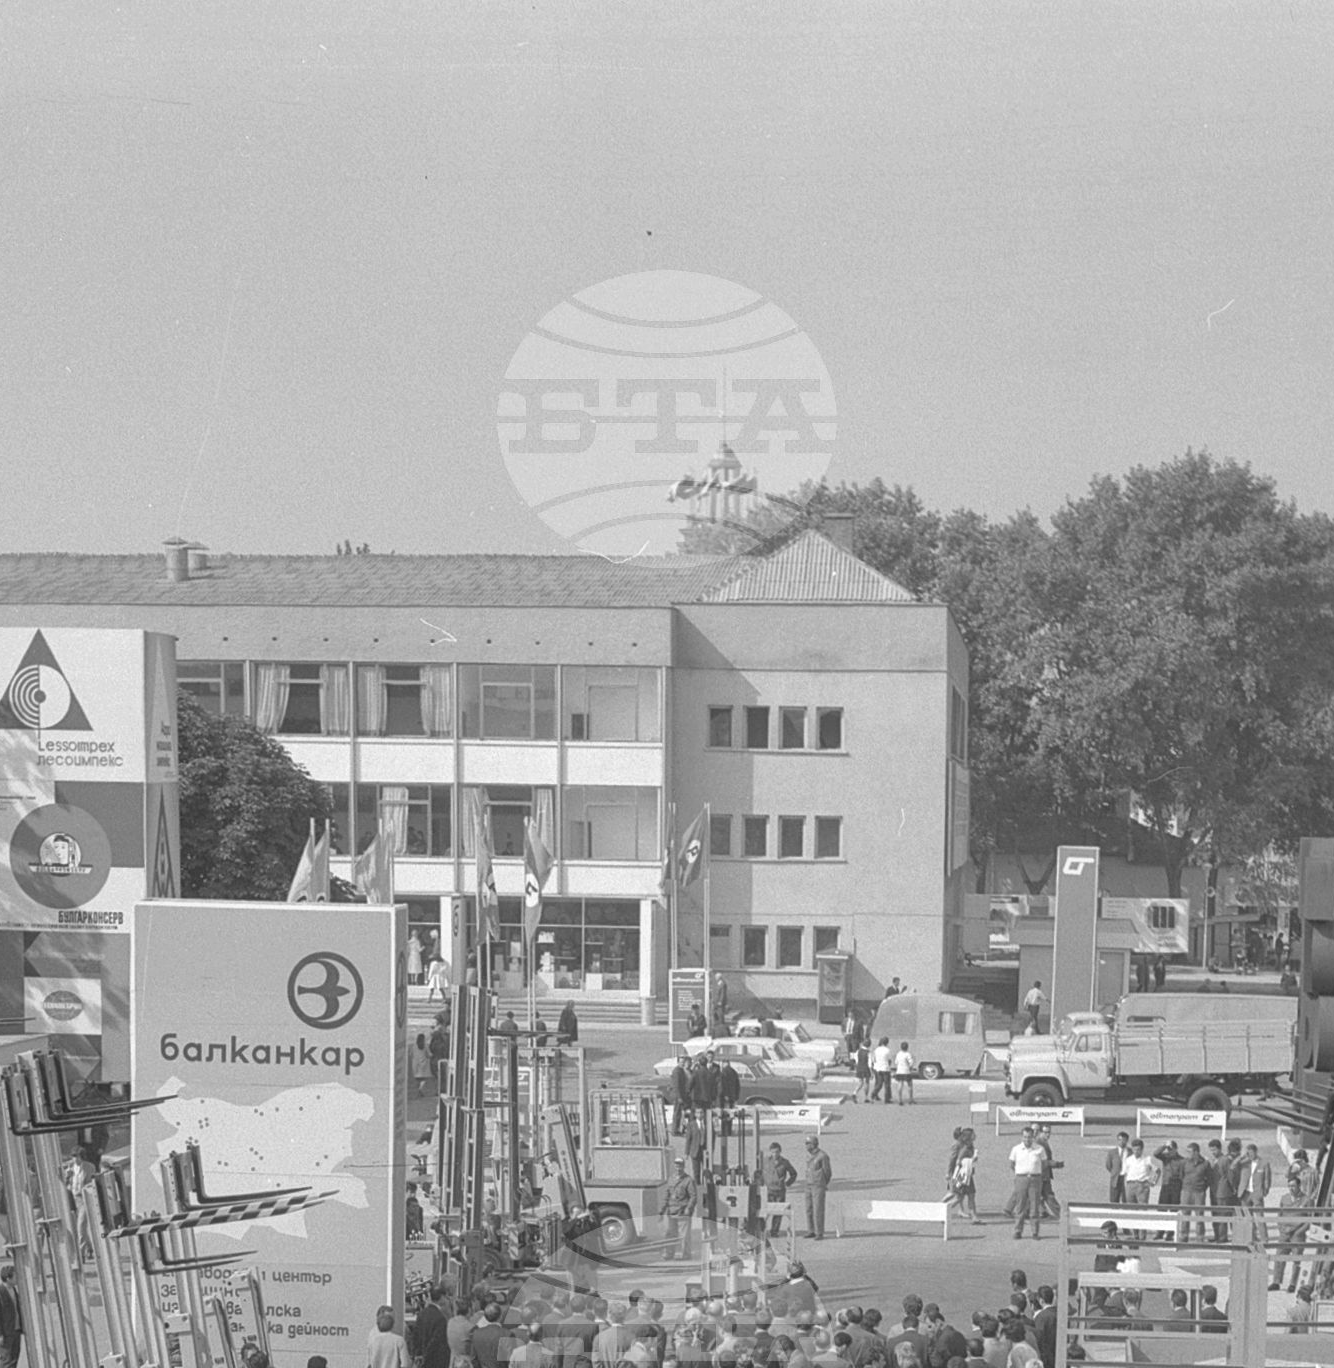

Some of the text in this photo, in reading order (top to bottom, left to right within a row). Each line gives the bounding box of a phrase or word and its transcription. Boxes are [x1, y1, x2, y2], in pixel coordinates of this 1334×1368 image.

[58, 911, 124, 925] БУЛГАРКОНСЕРВ
[160, 1033, 365, 1076] балканкар
[272, 1270, 332, 1286] център
[287, 1321, 349, 1338] дейност
